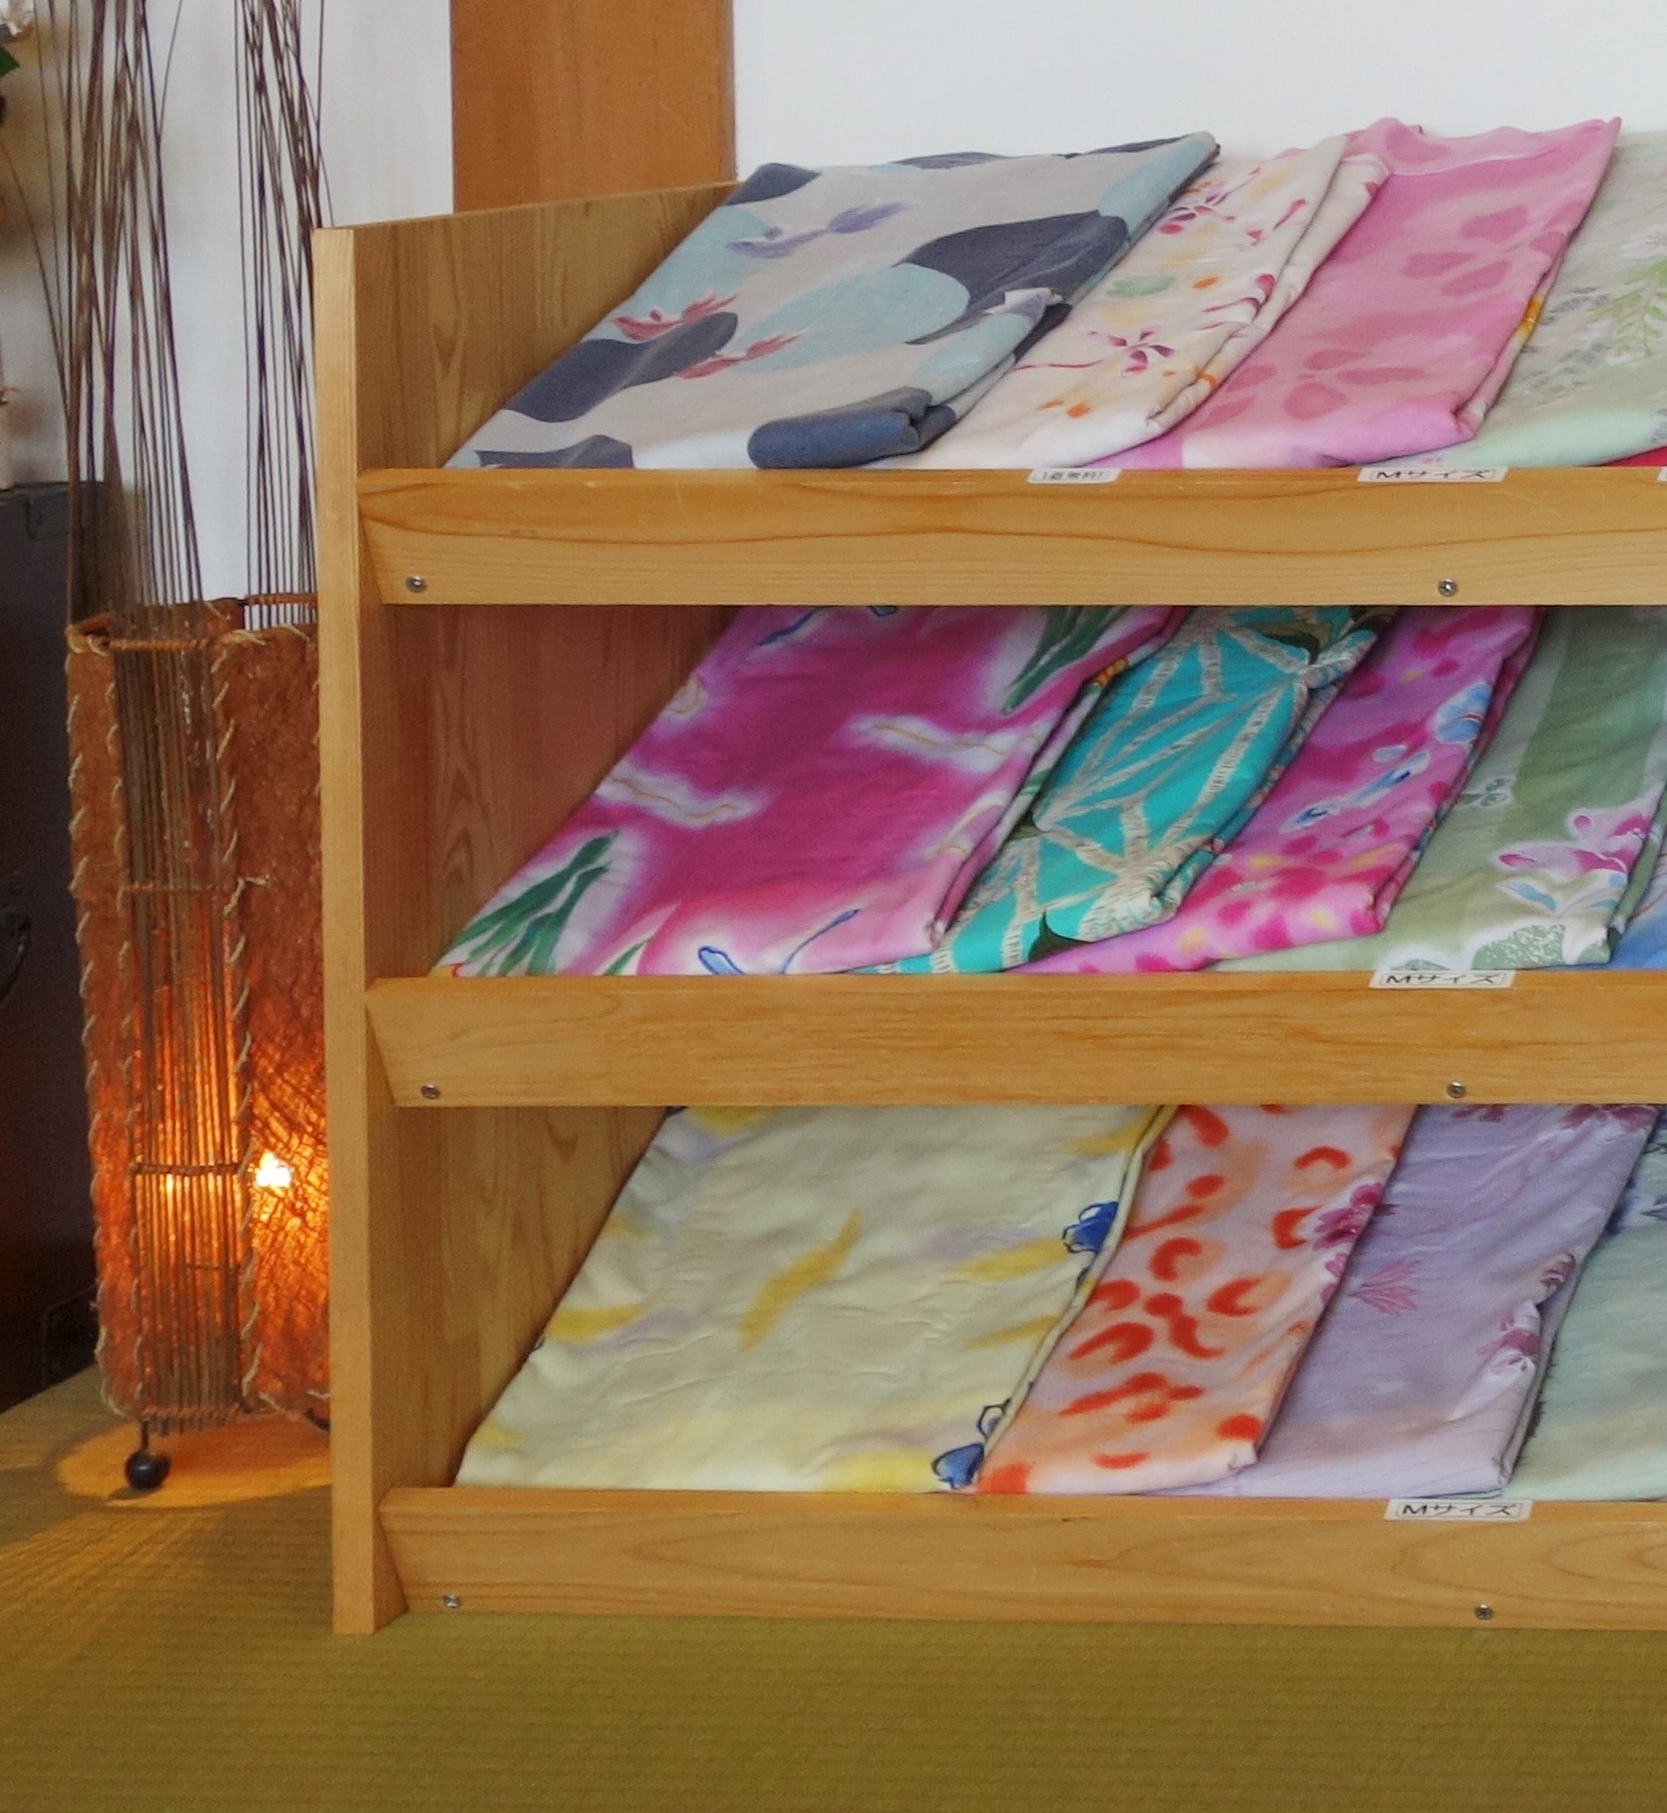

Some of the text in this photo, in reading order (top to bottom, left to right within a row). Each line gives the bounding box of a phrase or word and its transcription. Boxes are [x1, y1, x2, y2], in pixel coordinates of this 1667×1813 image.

[1386, 974, 1499, 984] Mサイズ
[1402, 1503, 1517, 1515] Mサイズ
